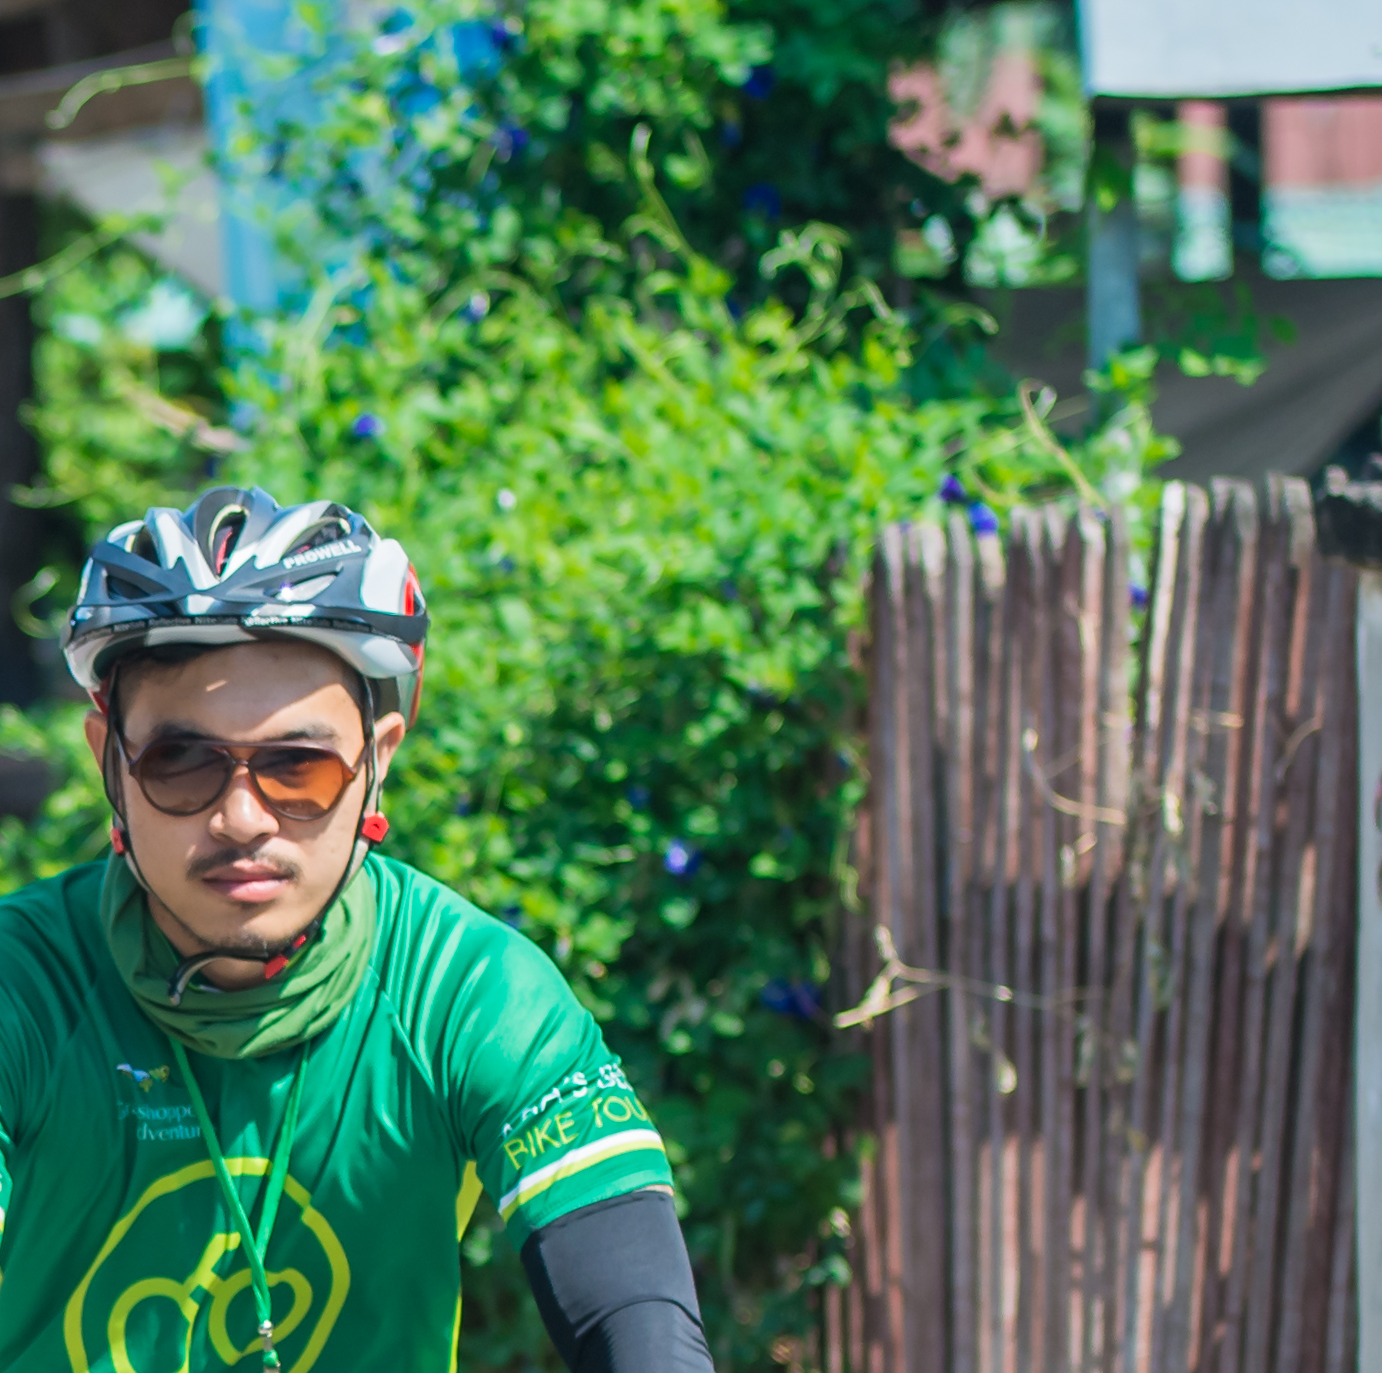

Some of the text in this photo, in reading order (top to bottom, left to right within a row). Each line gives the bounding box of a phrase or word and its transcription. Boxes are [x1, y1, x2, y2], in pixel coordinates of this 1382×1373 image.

[282, 539, 362, 569] PROWELL
[503, 1095, 649, 1170] BIKE TOU
